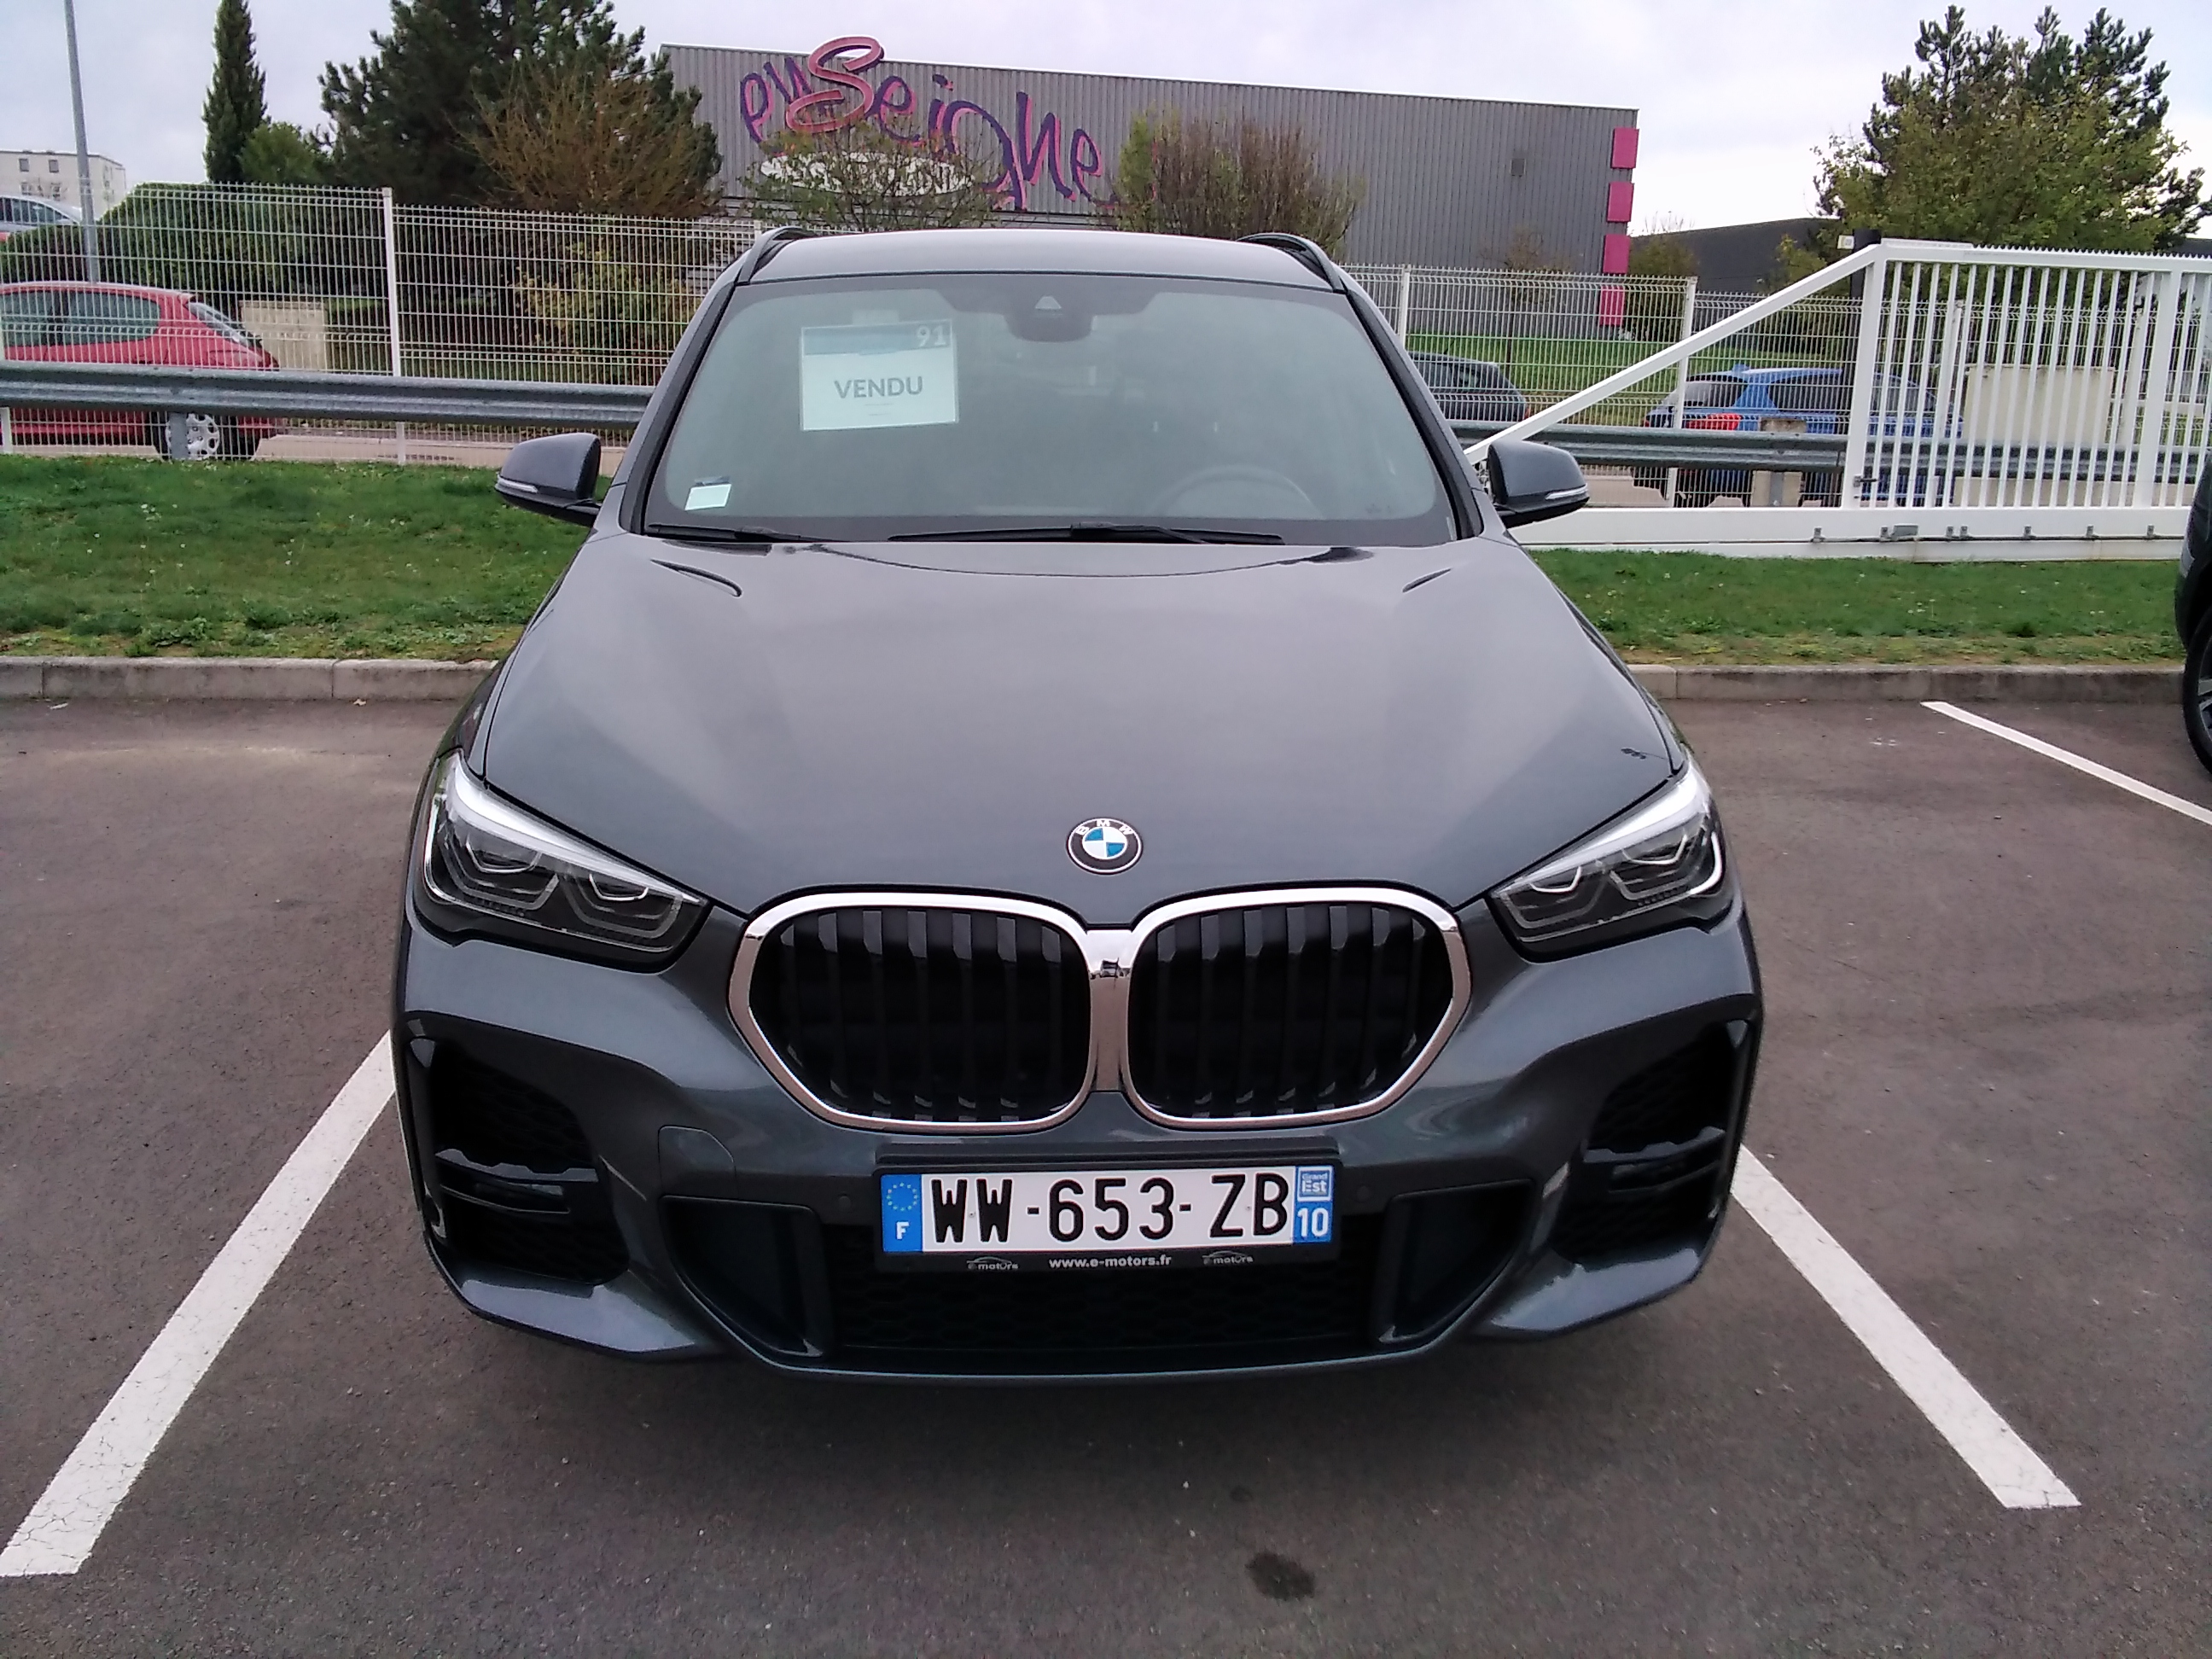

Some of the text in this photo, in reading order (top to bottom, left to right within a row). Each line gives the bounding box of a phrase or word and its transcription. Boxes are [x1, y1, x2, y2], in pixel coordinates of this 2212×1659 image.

[917, 325, 947, 346] 91
[835, 376, 923, 399] VENDU
[1302, 1180, 1328, 1193] Est
[895, 1221, 910, 1241] F
[1297, 1208, 1329, 1237] 10
[1049, 1254, 1173, 1270] www.e-motors.fr
